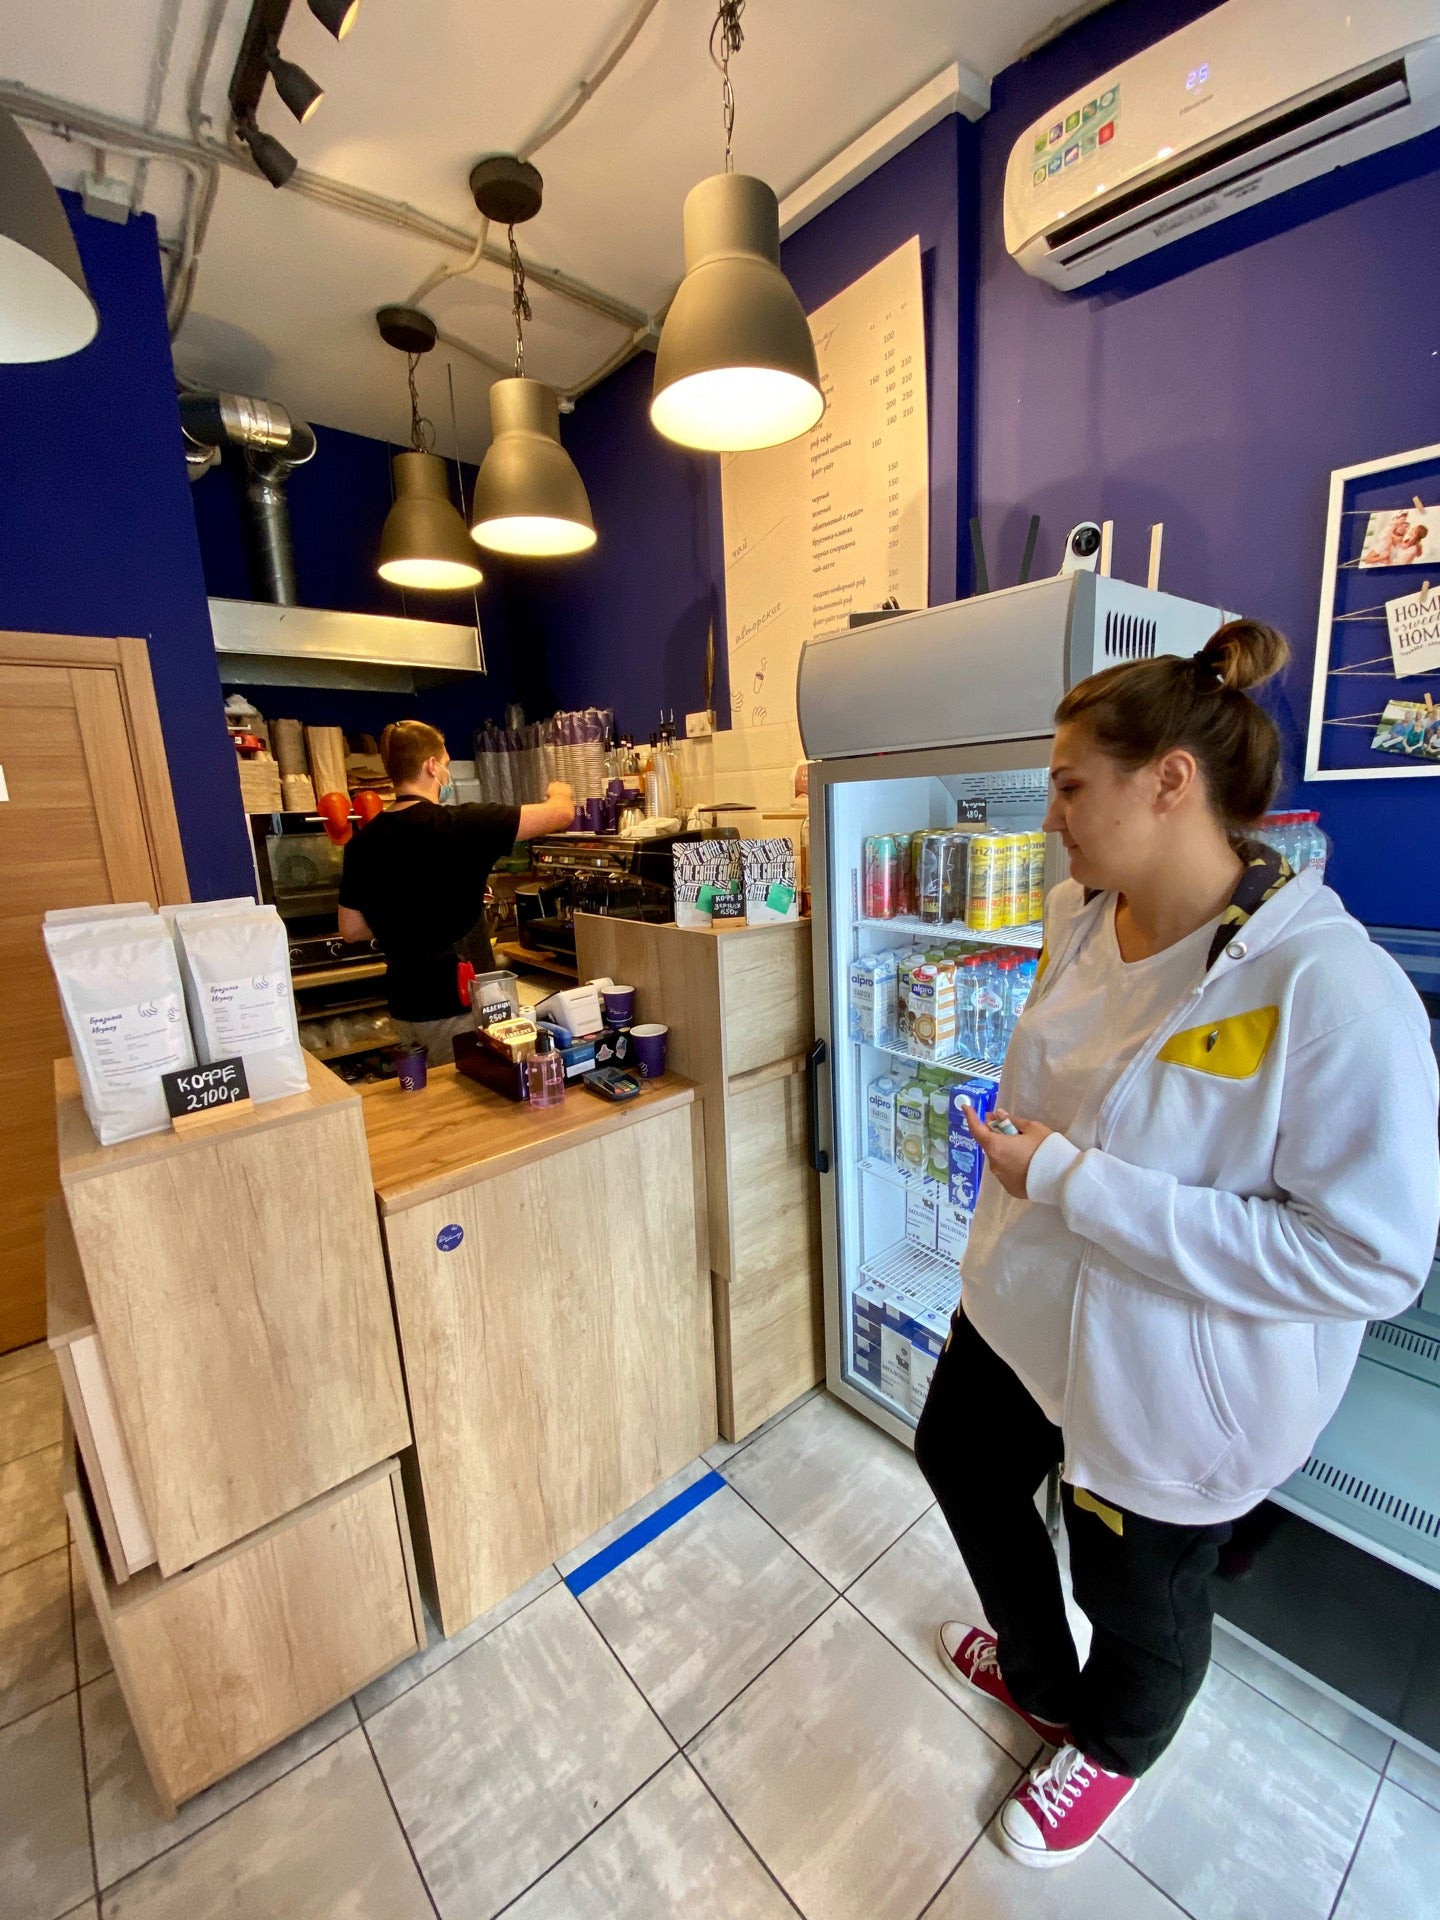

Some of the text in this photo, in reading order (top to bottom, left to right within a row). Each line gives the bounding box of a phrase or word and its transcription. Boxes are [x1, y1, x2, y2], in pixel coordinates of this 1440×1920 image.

[1186, 63, 1209, 90] 25
[884, 331, 895, 344] 100
[732, 537, 748, 558] чай
[734, 602, 782, 644] авторские
[695, 865, 717, 881] COFFEE
[763, 863, 783, 879] COFFEE
[851, 974, 874, 987] alpro
[913, 985, 933, 995] alpro
[176, 1064, 236, 1092] КОФЕ
[187, 1086, 240, 1110] 2100р
[869, 1094, 891, 1109] alpro
[901, 1106, 920, 1118] alpro
